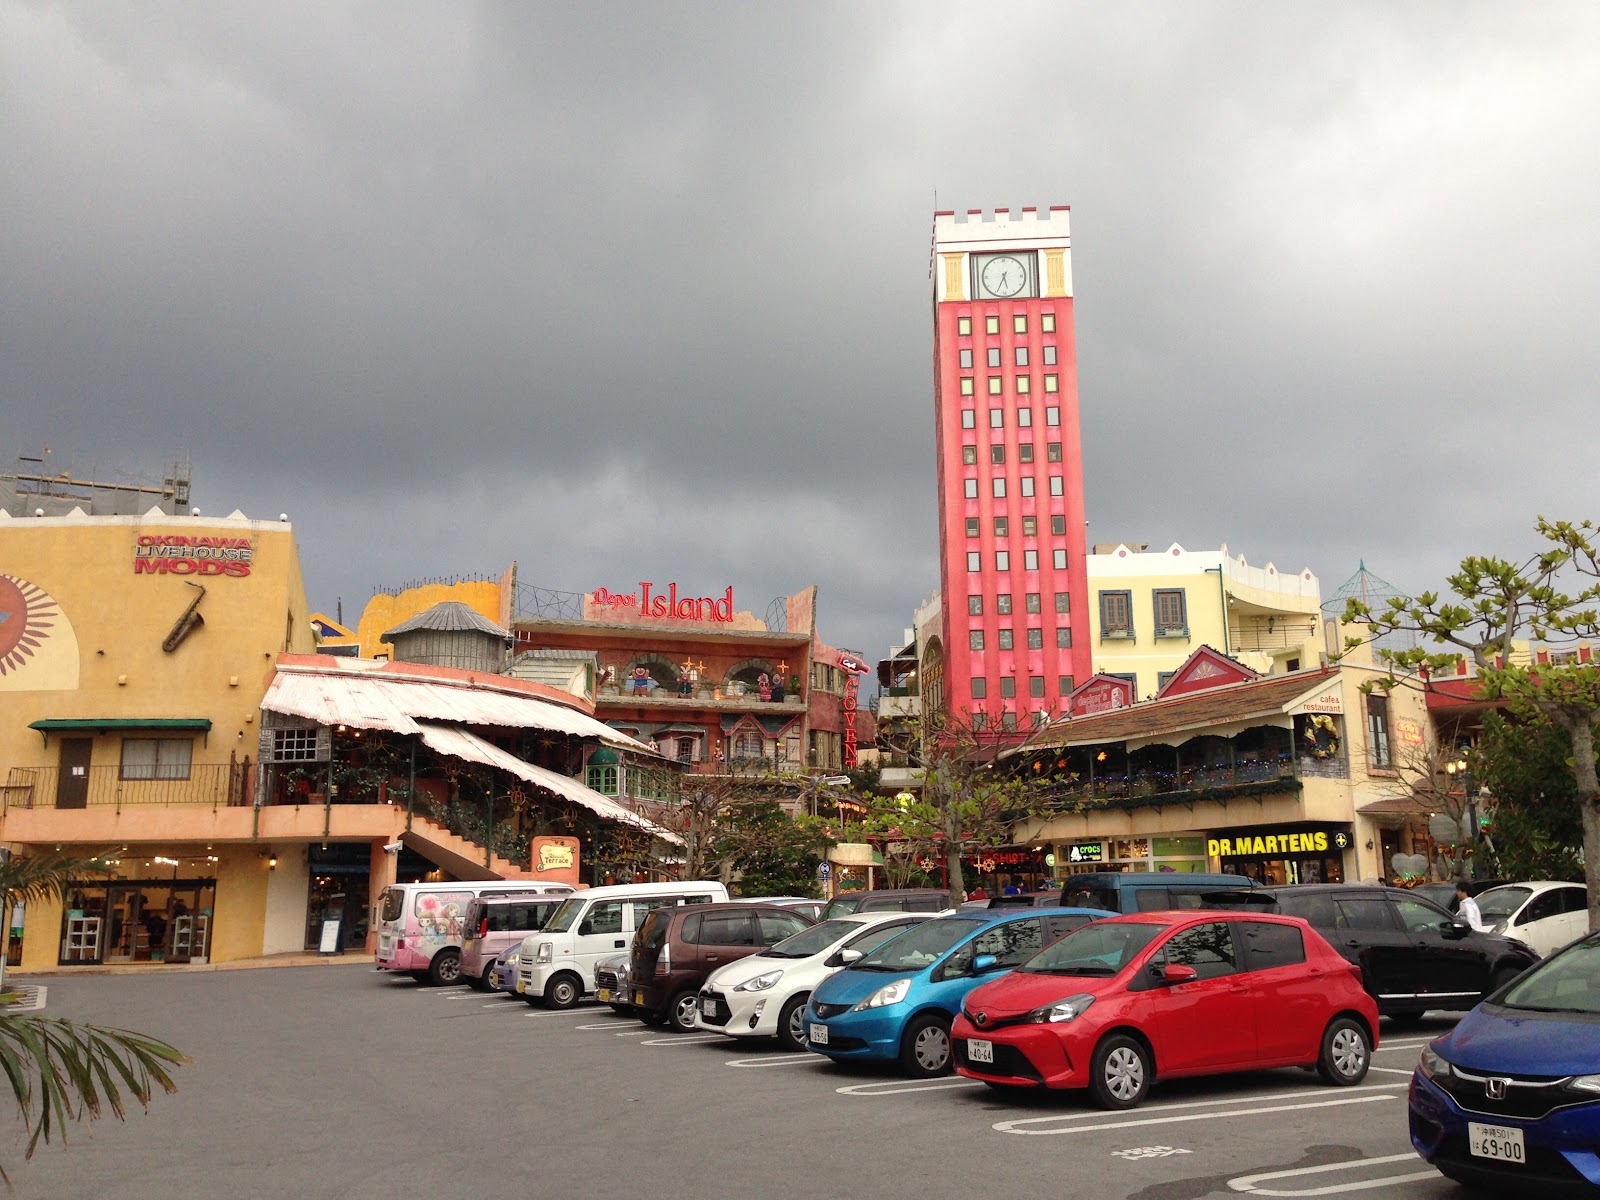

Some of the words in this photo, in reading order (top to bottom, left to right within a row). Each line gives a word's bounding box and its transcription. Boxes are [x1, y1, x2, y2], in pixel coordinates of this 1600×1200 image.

[137, 535, 251, 549] OKINAWA
[136, 545, 252, 561] LIVEHOUSE
[134, 557, 251, 577] MODS
[638, 581, 733, 622] Island
[1303, 703, 1341, 712] restaurant
[843, 678, 859, 769] COVENT
[1080, 845, 1101, 854] crocs
[1208, 832, 1328, 856] DR.MARTENS
[974, 1048, 992, 1061] 40-64
[1482, 1139, 1521, 1159] 69-00
